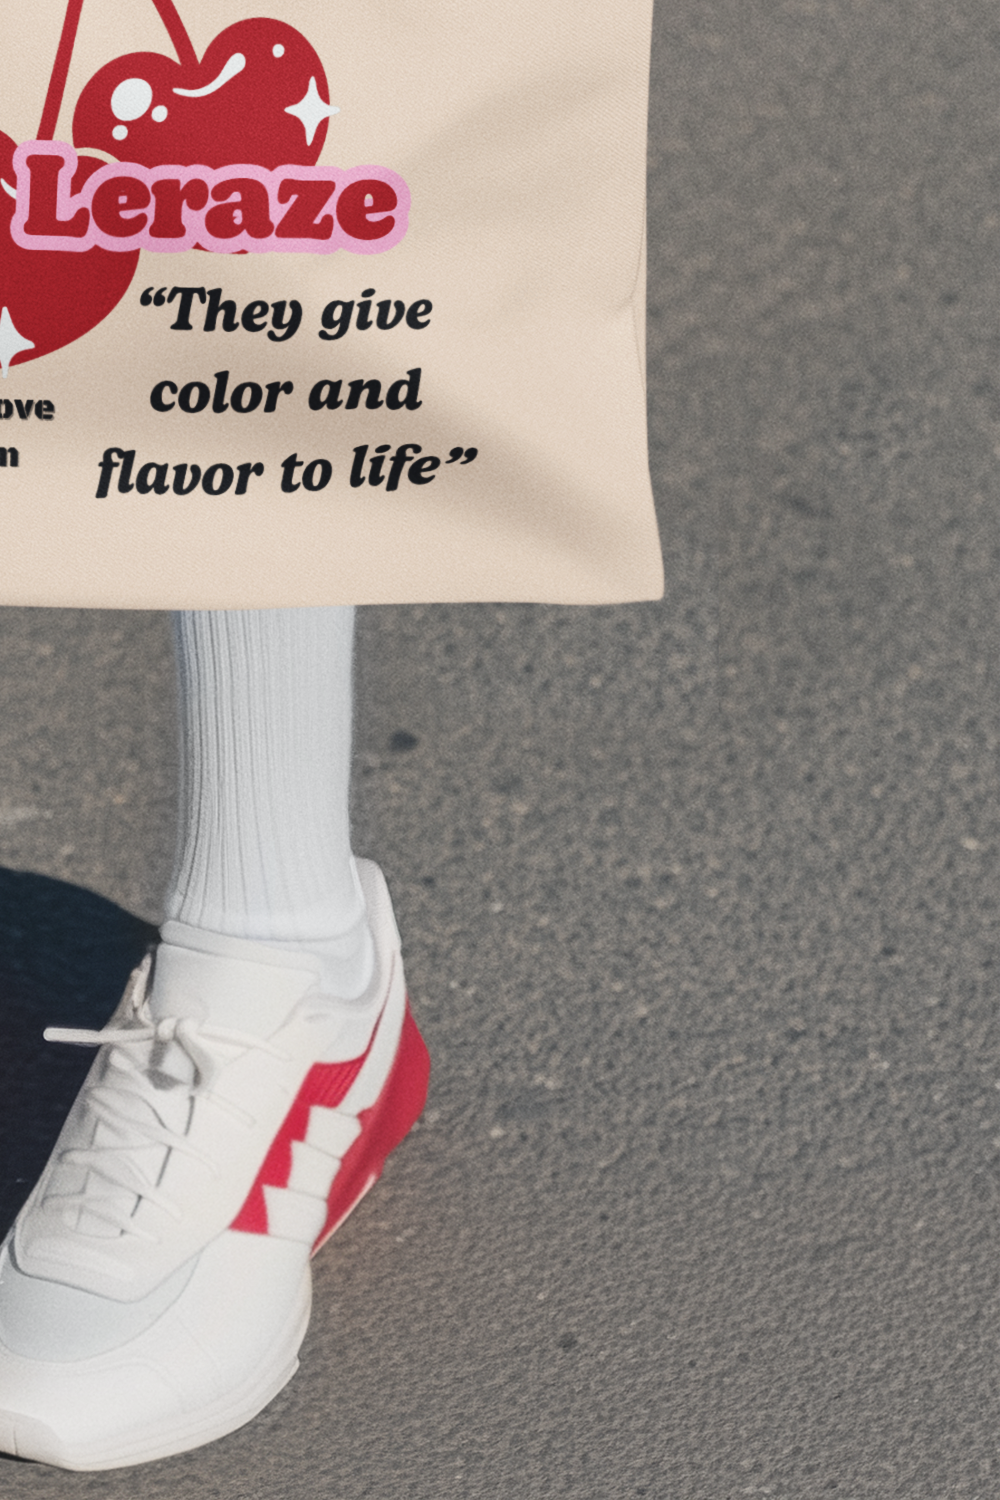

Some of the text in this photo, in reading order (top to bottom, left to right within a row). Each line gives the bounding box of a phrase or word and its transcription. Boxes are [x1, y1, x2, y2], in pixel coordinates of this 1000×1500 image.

[22, 152, 400, 242] Leraze
[139, 286, 433, 343] “They give
[149, 367, 423, 414] color and
[95, 443, 479, 499] flavor to life”
